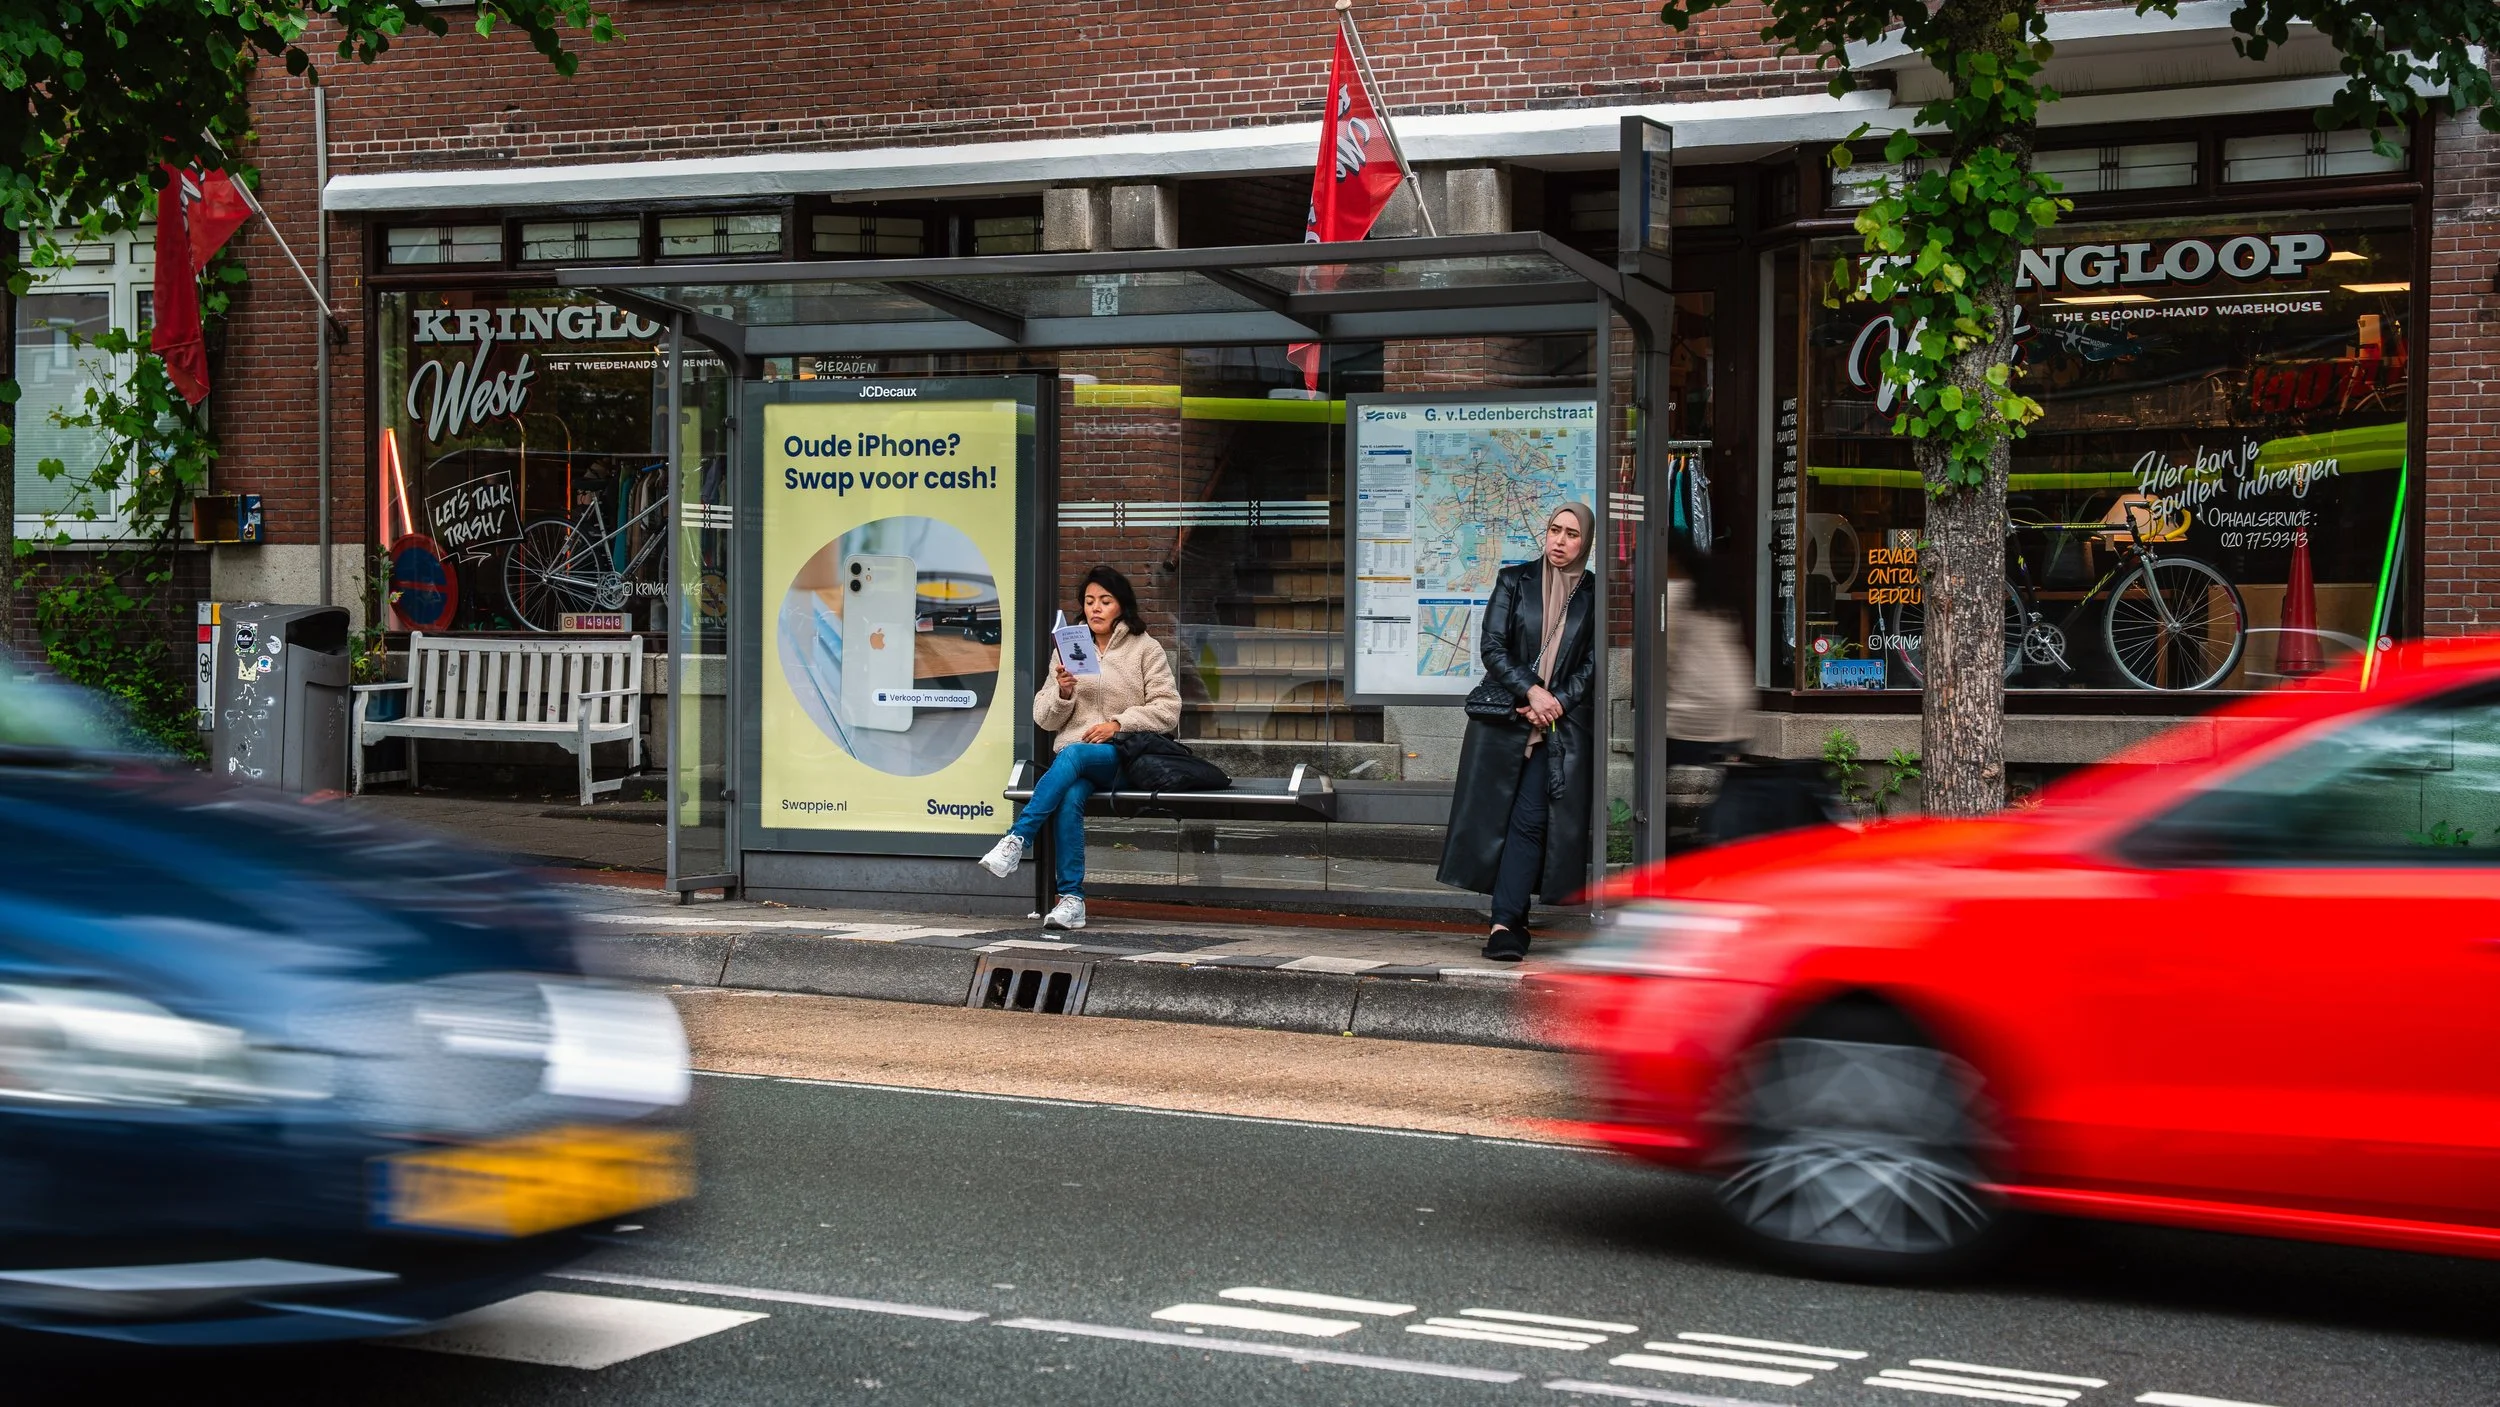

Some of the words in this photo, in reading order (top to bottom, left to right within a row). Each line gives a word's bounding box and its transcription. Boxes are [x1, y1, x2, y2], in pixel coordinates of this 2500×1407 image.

[2052, 312, 2084, 323] THE
[2091, 306, 2209, 322] SECOND-HAND
[2216, 301, 2323, 316] WAREHOUSE
[549, 361, 571, 371] HET
[574, 360, 658, 371] TWEEDEHANDS
[814, 360, 877, 374] SIERADEN
[406, 338, 535, 442] West
[859, 386, 917, 398] JCDecaux
[1386, 411, 1407, 420] GVB
[1424, 407, 1441, 421] G.
[784, 434, 852, 458] Oude
[857, 432, 961, 457] iPhone?
[2132, 450, 2188, 499] Hier
[2194, 445, 2235, 477] kan
[2233, 435, 2260, 478] je
[784, 466, 854, 497] Swap
[860, 471, 918, 490] voor
[923, 465, 997, 489] cash!
[2150, 476, 2228, 526] spullen
[2237, 458, 2340, 500] inbrengen
[435, 488, 470, 527] LET'S
[471, 484, 511, 511] TALK
[443, 509, 506, 548] TRASH!
[2220, 531, 2243, 548] 020
[2246, 531, 2309, 549] 7759343
[1824, 666, 1883, 676] TORONTO
[889, 693, 921, 704] Verkoop
[922, 693, 933, 702] 'm
[934, 694, 970, 705] vandaag!
[781, 799, 847, 813] Swappie.nl
[926, 798, 994, 820] Swappie
